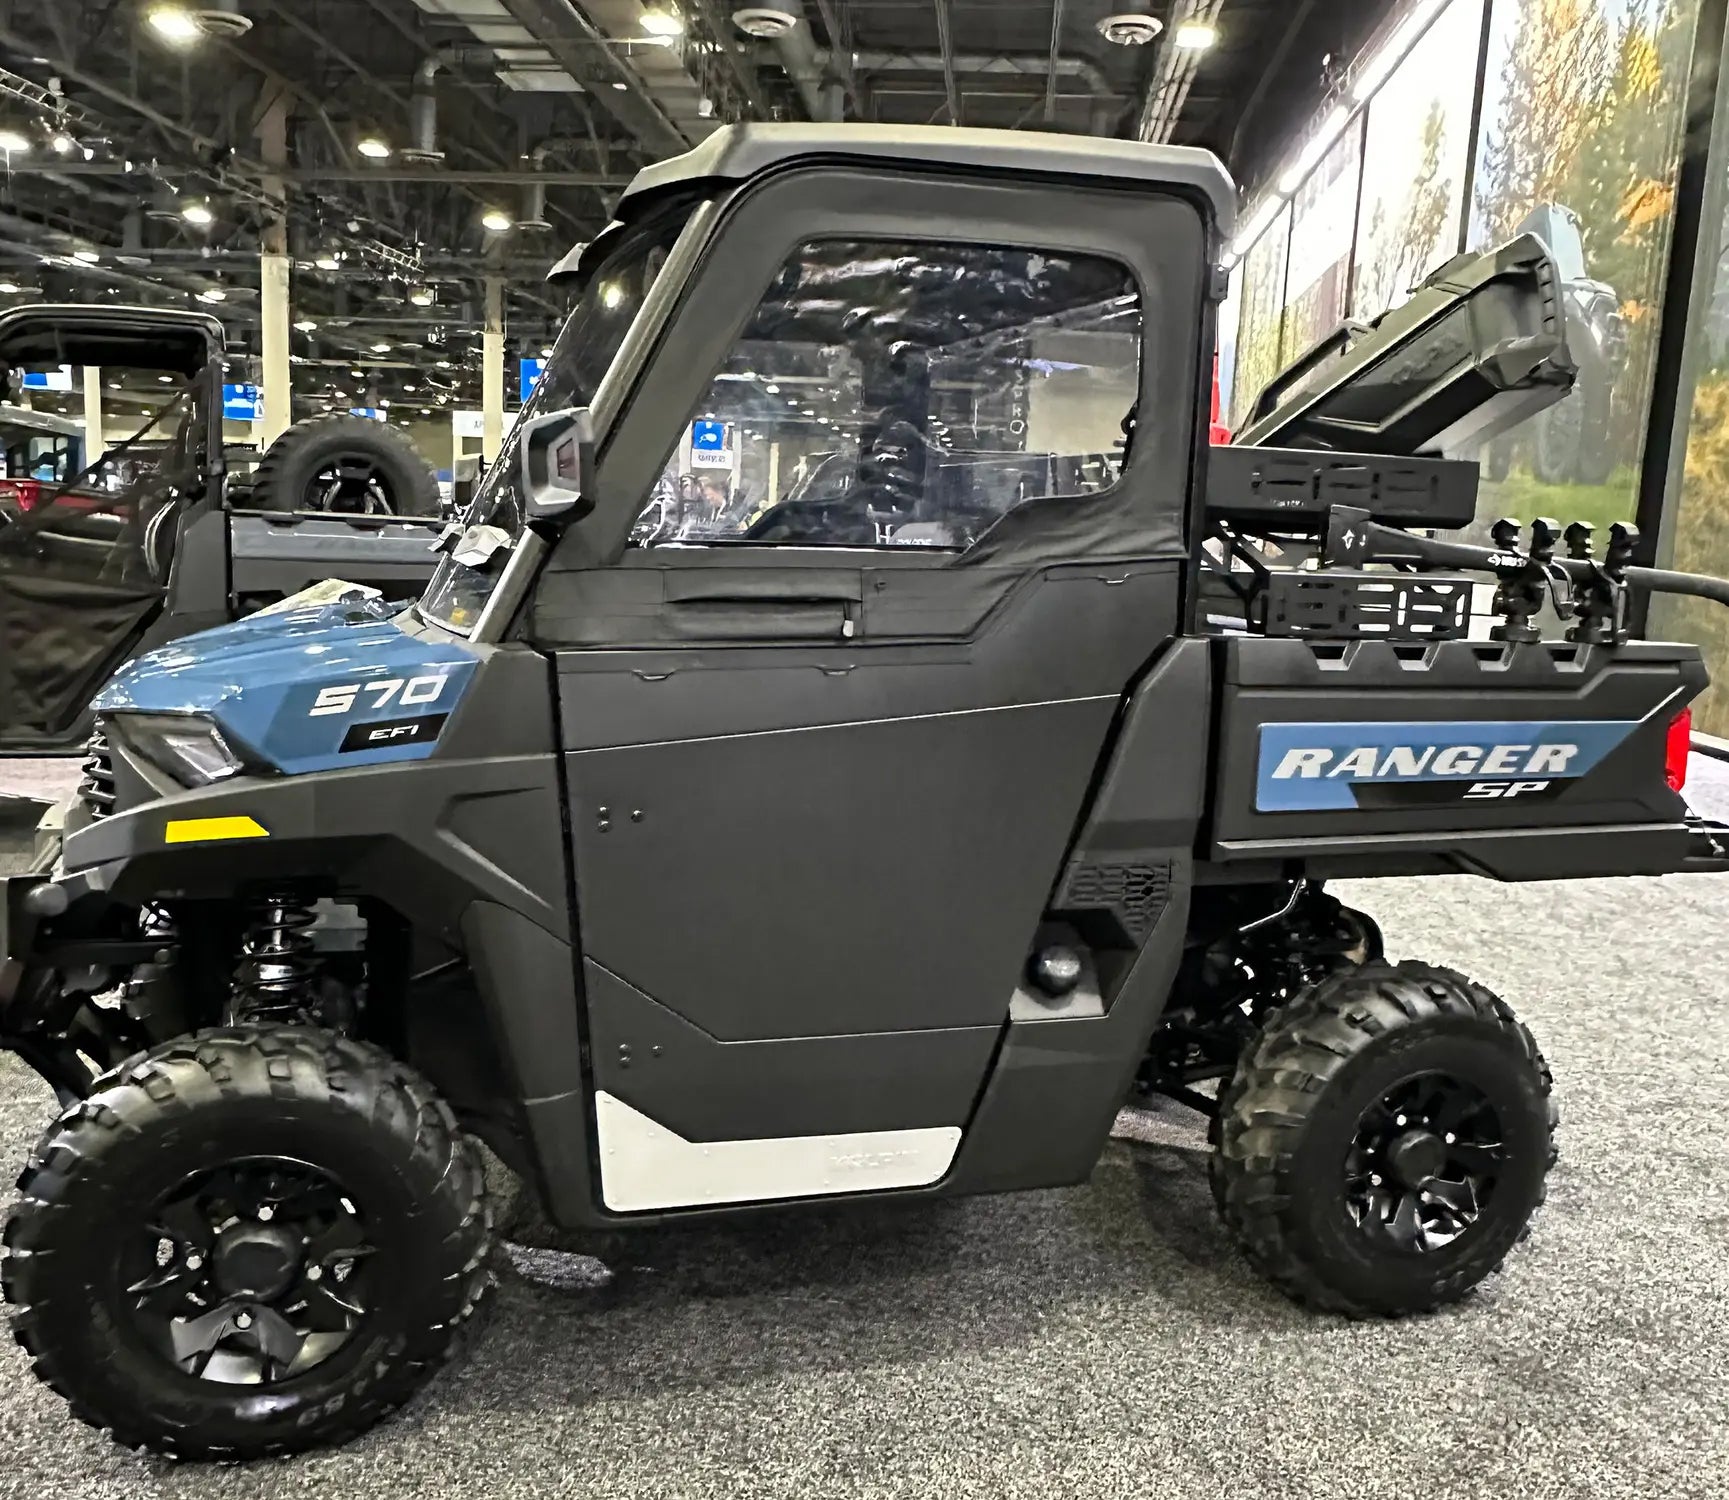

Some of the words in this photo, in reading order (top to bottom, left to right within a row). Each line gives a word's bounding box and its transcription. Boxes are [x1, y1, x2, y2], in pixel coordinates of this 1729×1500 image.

[309, 674, 448, 716] 570
[368, 725, 419, 740] EFI
[1272, 744, 1578, 778] RANGER
[1462, 781, 1552, 799] SP
